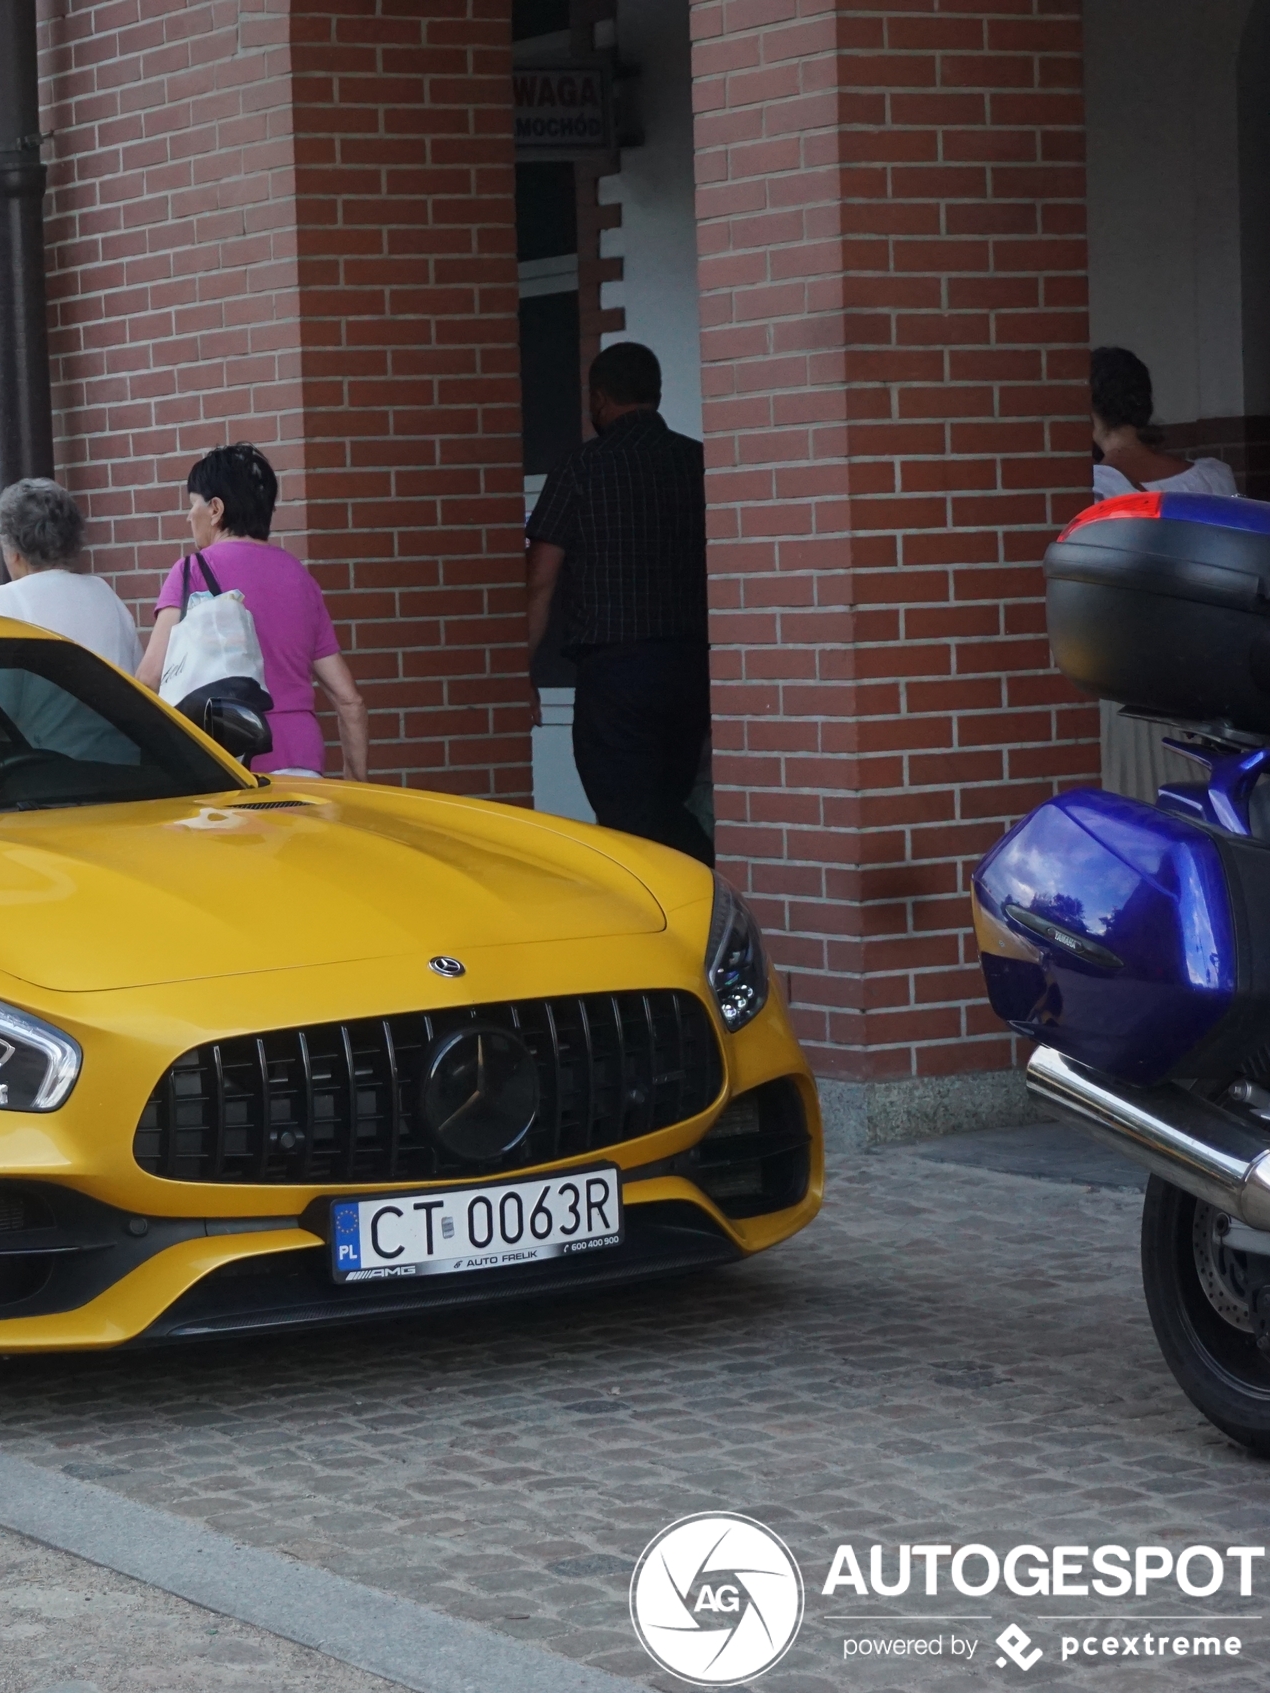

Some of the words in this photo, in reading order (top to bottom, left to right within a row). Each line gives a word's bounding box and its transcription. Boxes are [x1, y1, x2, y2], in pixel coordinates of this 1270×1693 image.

[512, 76, 598, 107] WAGA
[370, 1199, 444, 1259] CT
[467, 1177, 611, 1249] 0063R
[338, 1244, 358, 1260] PL
[571, 1241, 586, 1252] 600
[587, 1239, 604, 1250] 400
[604, 1235, 620, 1247] 900
[466, 1256, 499, 1268] AUTO
[501, 1250, 538, 1263] FRELIK
[368, 1264, 416, 1279] AMG
